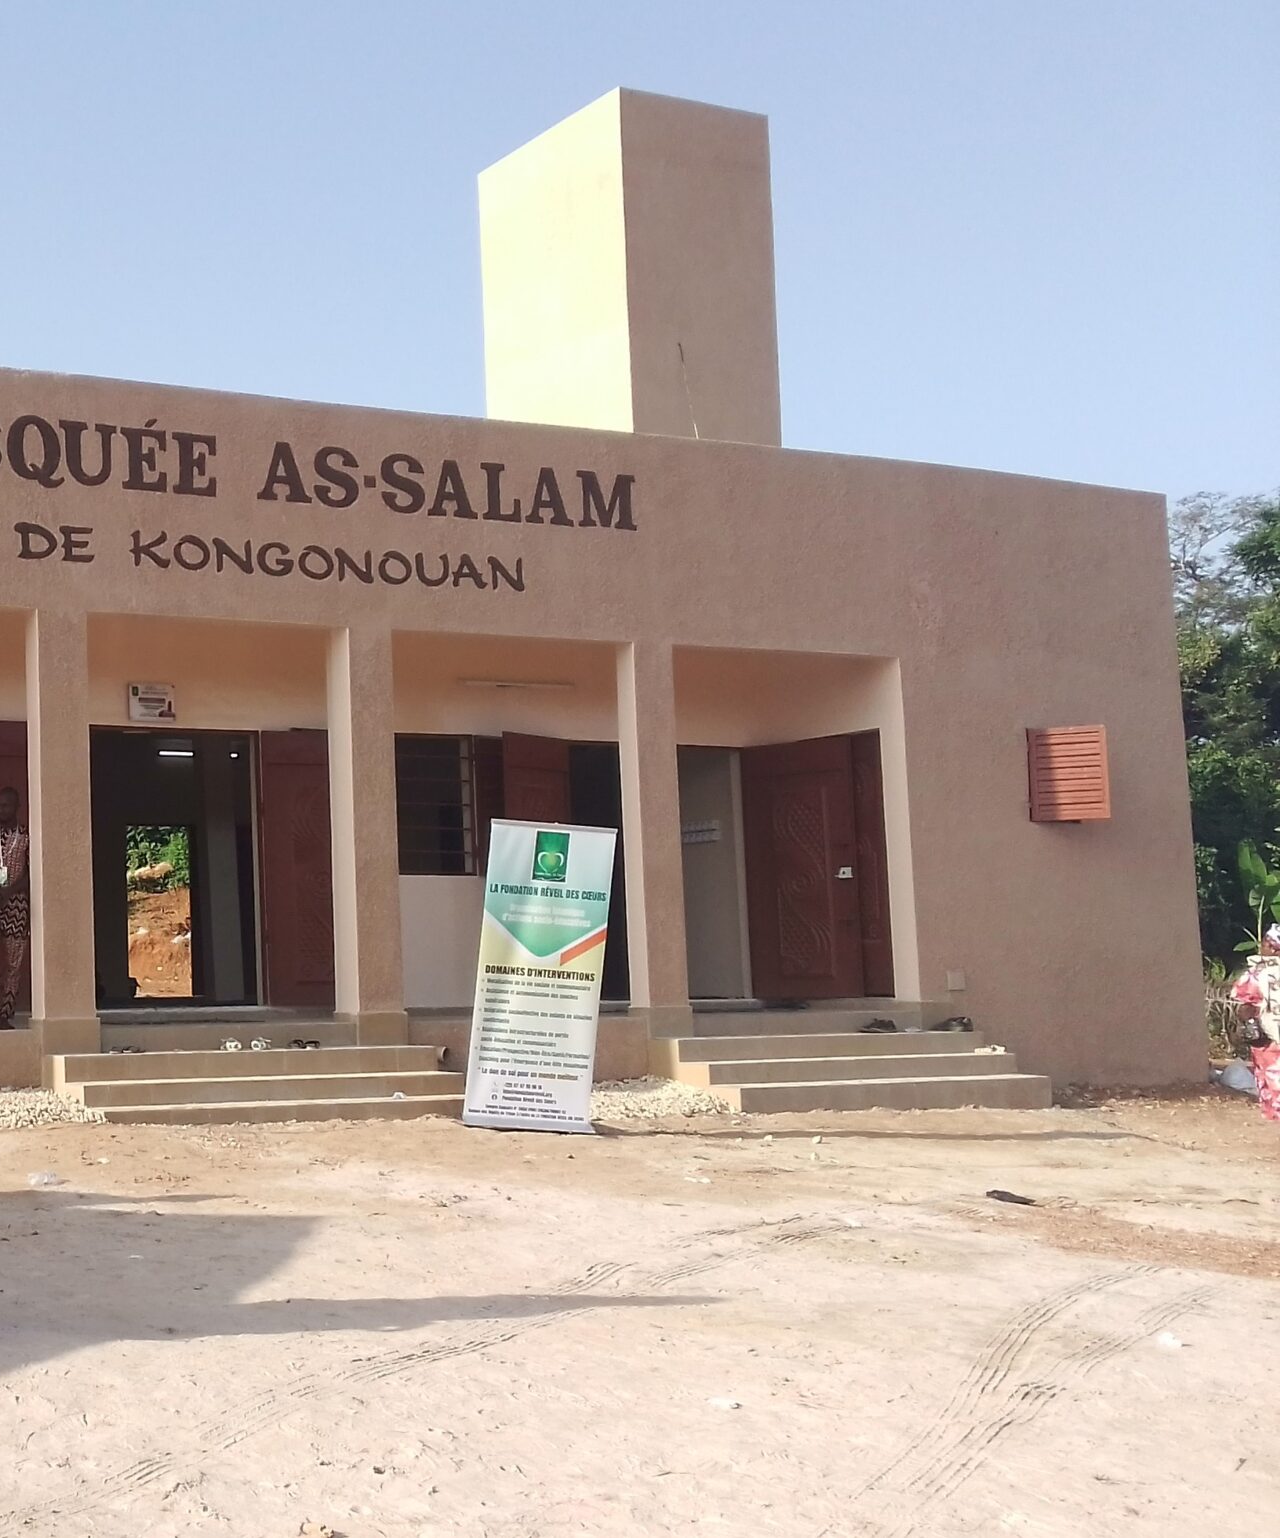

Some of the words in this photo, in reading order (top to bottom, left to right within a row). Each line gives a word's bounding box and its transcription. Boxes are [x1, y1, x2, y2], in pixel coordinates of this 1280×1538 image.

[14, 522, 95, 563] DE
[129, 530, 526, 592] KONGONOUAN
[490, 884, 499, 893] LA
[500, 884, 539, 896] FONDATION
[540, 887, 564, 898] RÉVEIL
[566, 890, 580, 899] DES
[485, 965, 526, 976] DOMAINES
[527, 968, 596, 982] D'INTERVENTIONS
